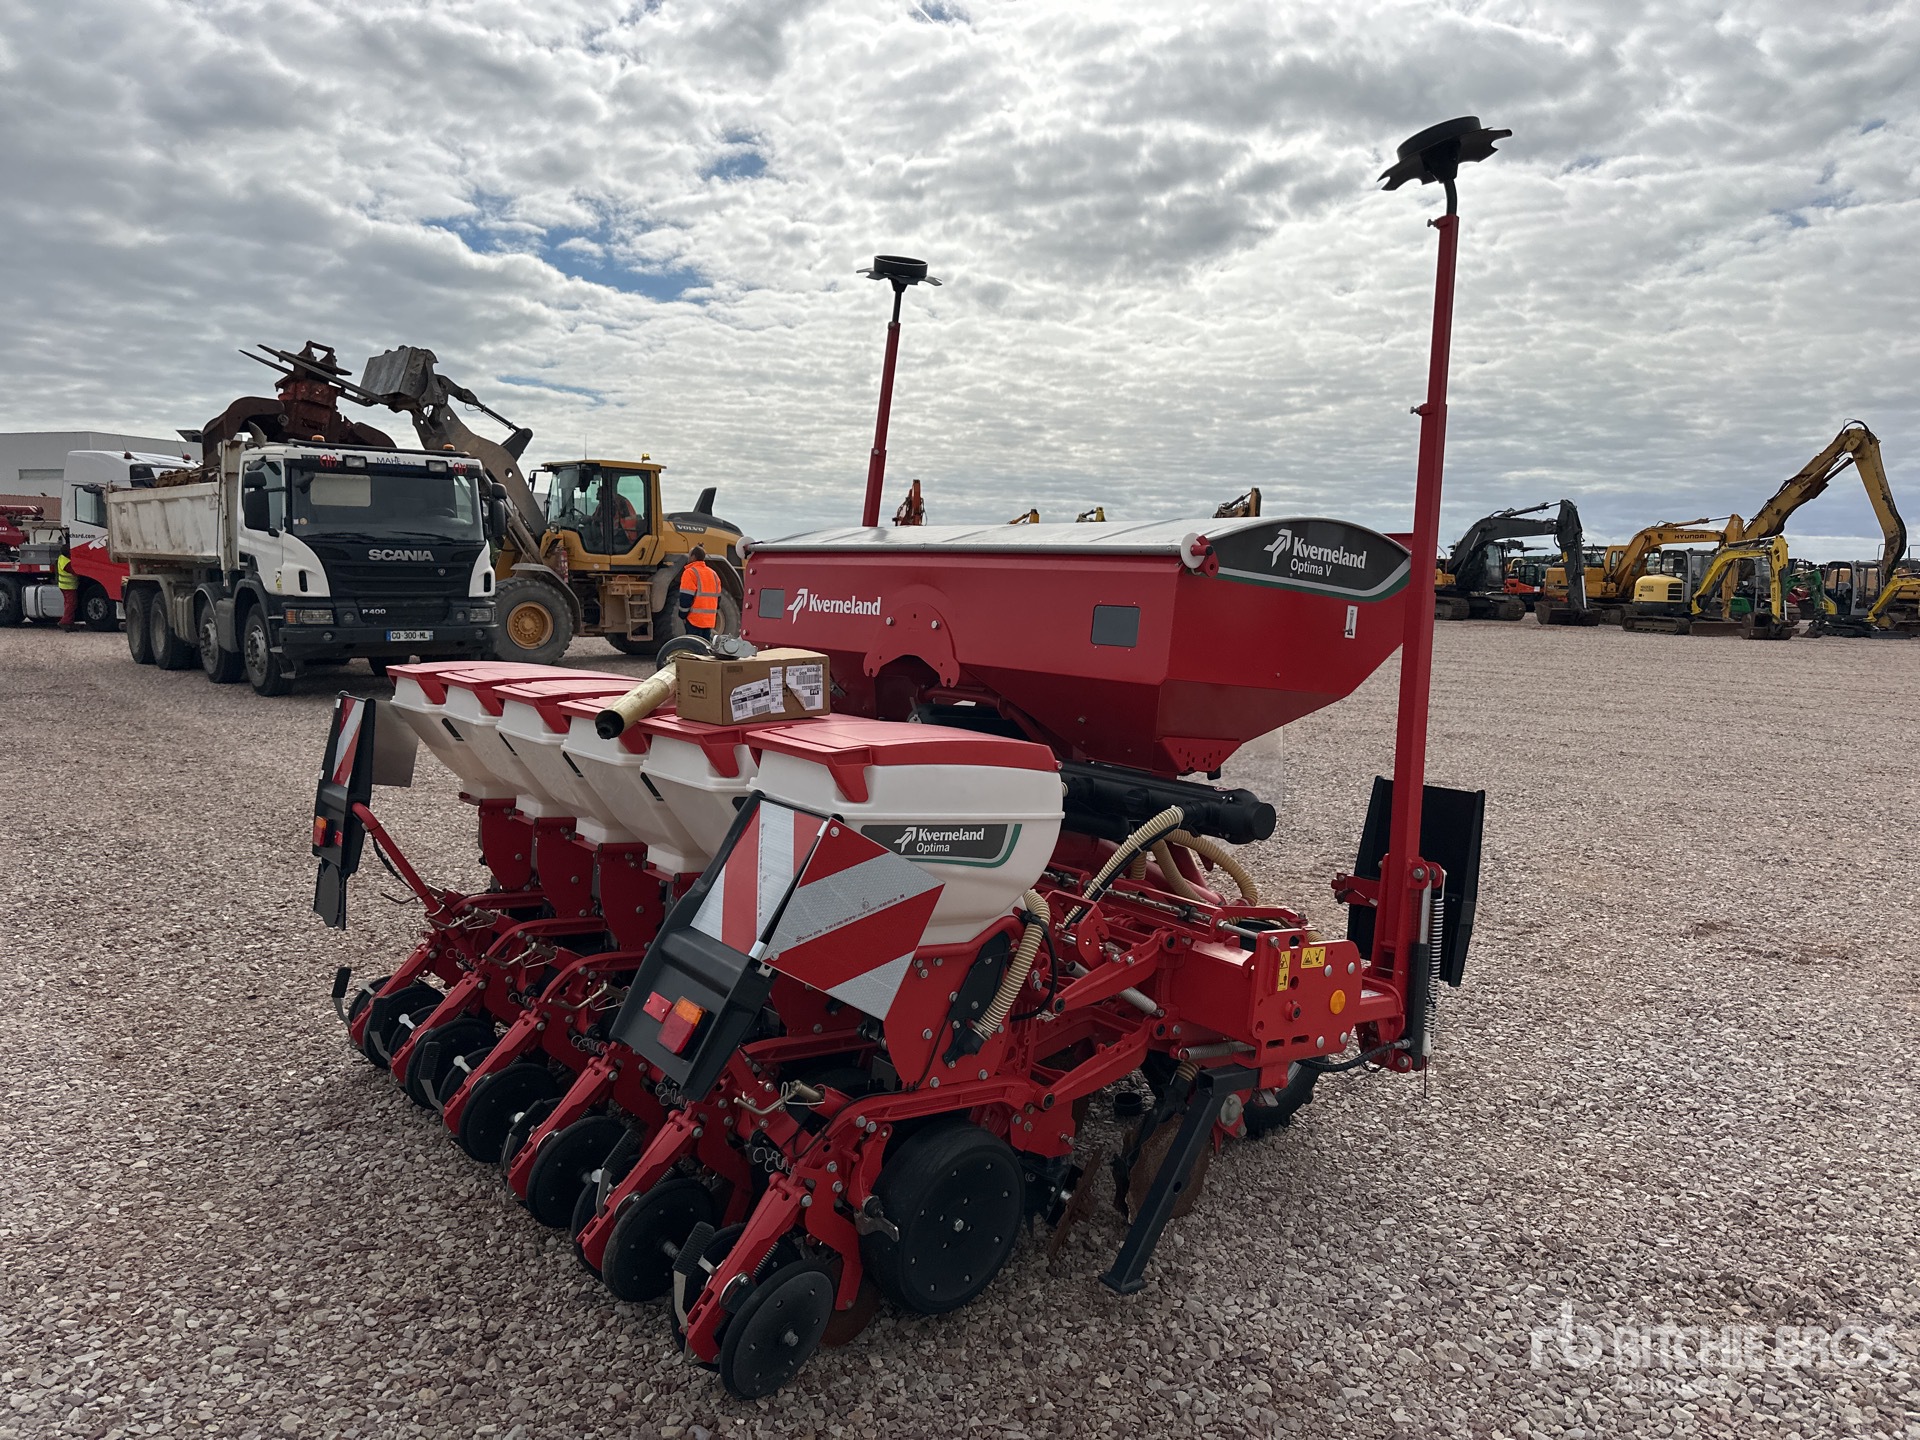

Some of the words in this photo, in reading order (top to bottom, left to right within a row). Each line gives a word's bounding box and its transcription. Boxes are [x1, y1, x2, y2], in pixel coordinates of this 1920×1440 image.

[368, 549, 434, 562] SCANIA
[1292, 536, 1367, 569] Kverneland
[1290, 558, 1323, 576] Optima
[1325, 564, 1333, 577] V
[808, 593, 882, 616] Kverneland
[690, 684, 705, 695] CNH
[917, 827, 985, 842] Kverneland
[916, 842, 950, 855] Optima
